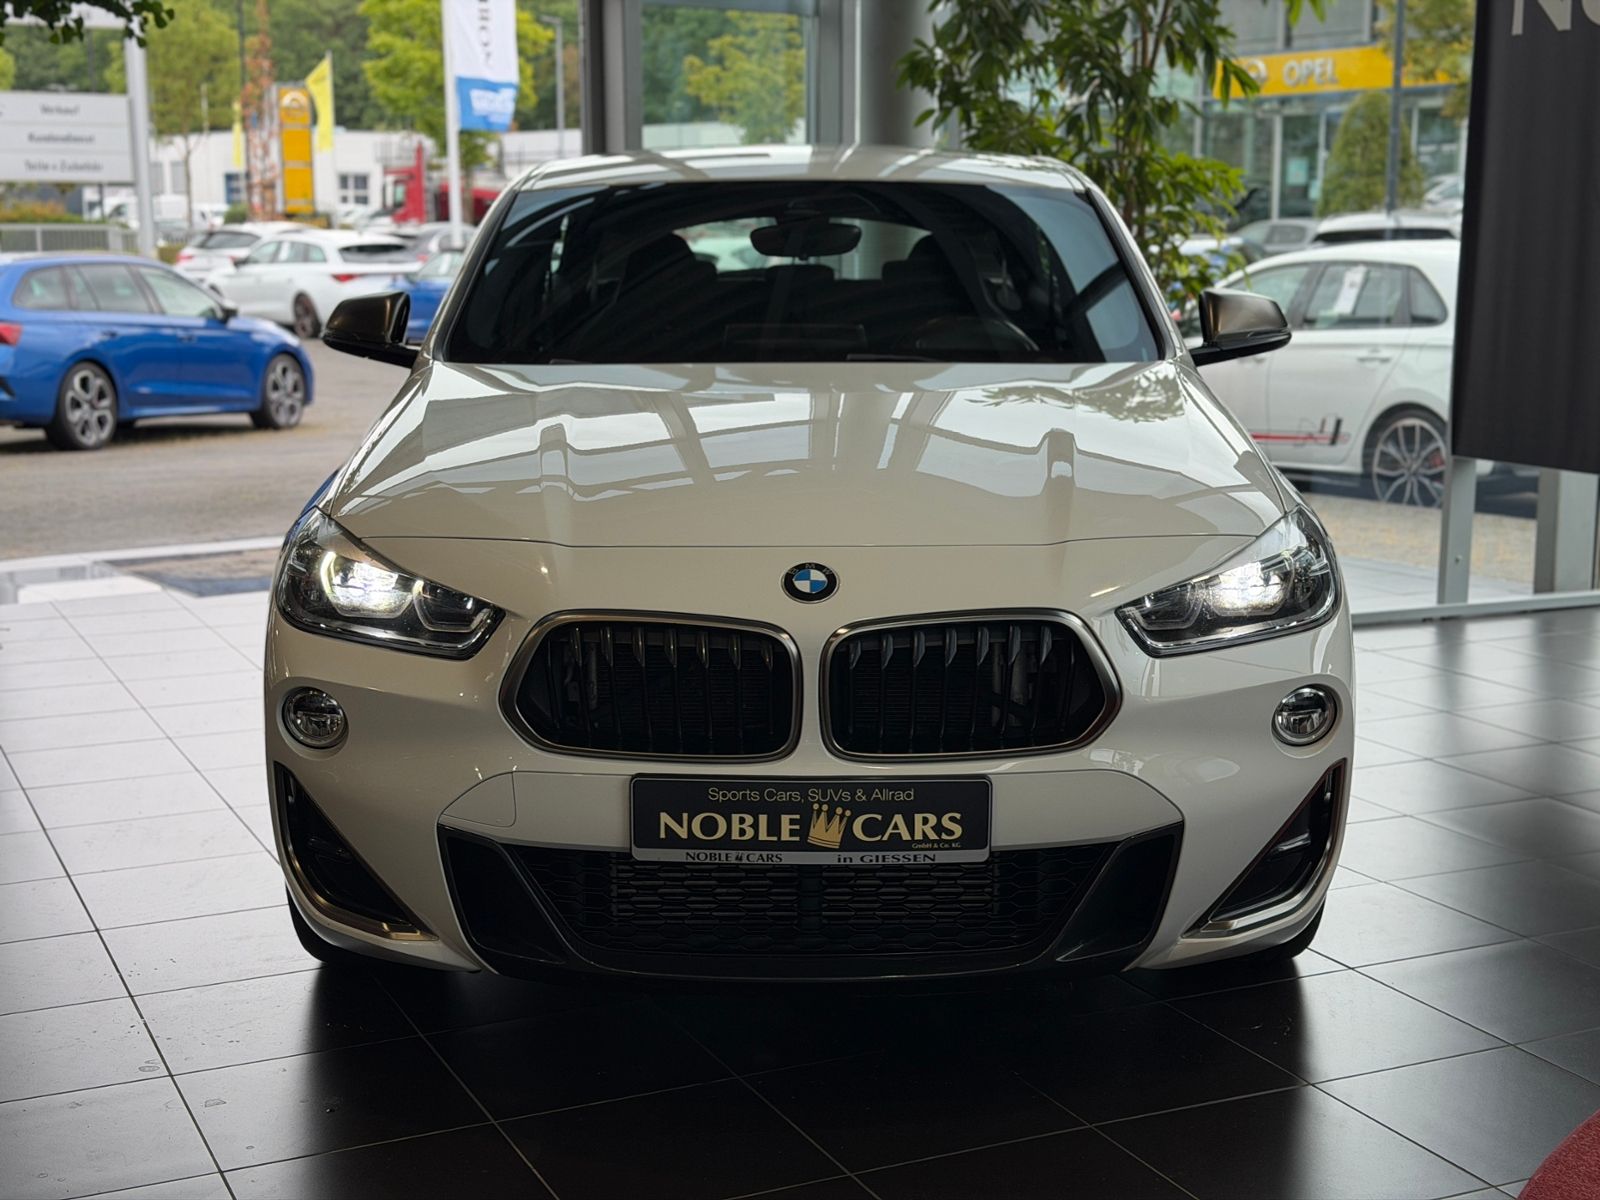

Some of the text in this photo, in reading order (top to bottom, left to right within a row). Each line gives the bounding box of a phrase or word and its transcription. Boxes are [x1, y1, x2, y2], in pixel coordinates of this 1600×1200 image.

[1282, 56, 1339, 88] OPEL
[707, 787, 915, 803] Sports Cars, SUVs & Allrad
[658, 811, 964, 842] NOBLE CARS
[685, 851, 783, 863] NOBLE CARS
[836, 853, 937, 863] in GIESSEN
